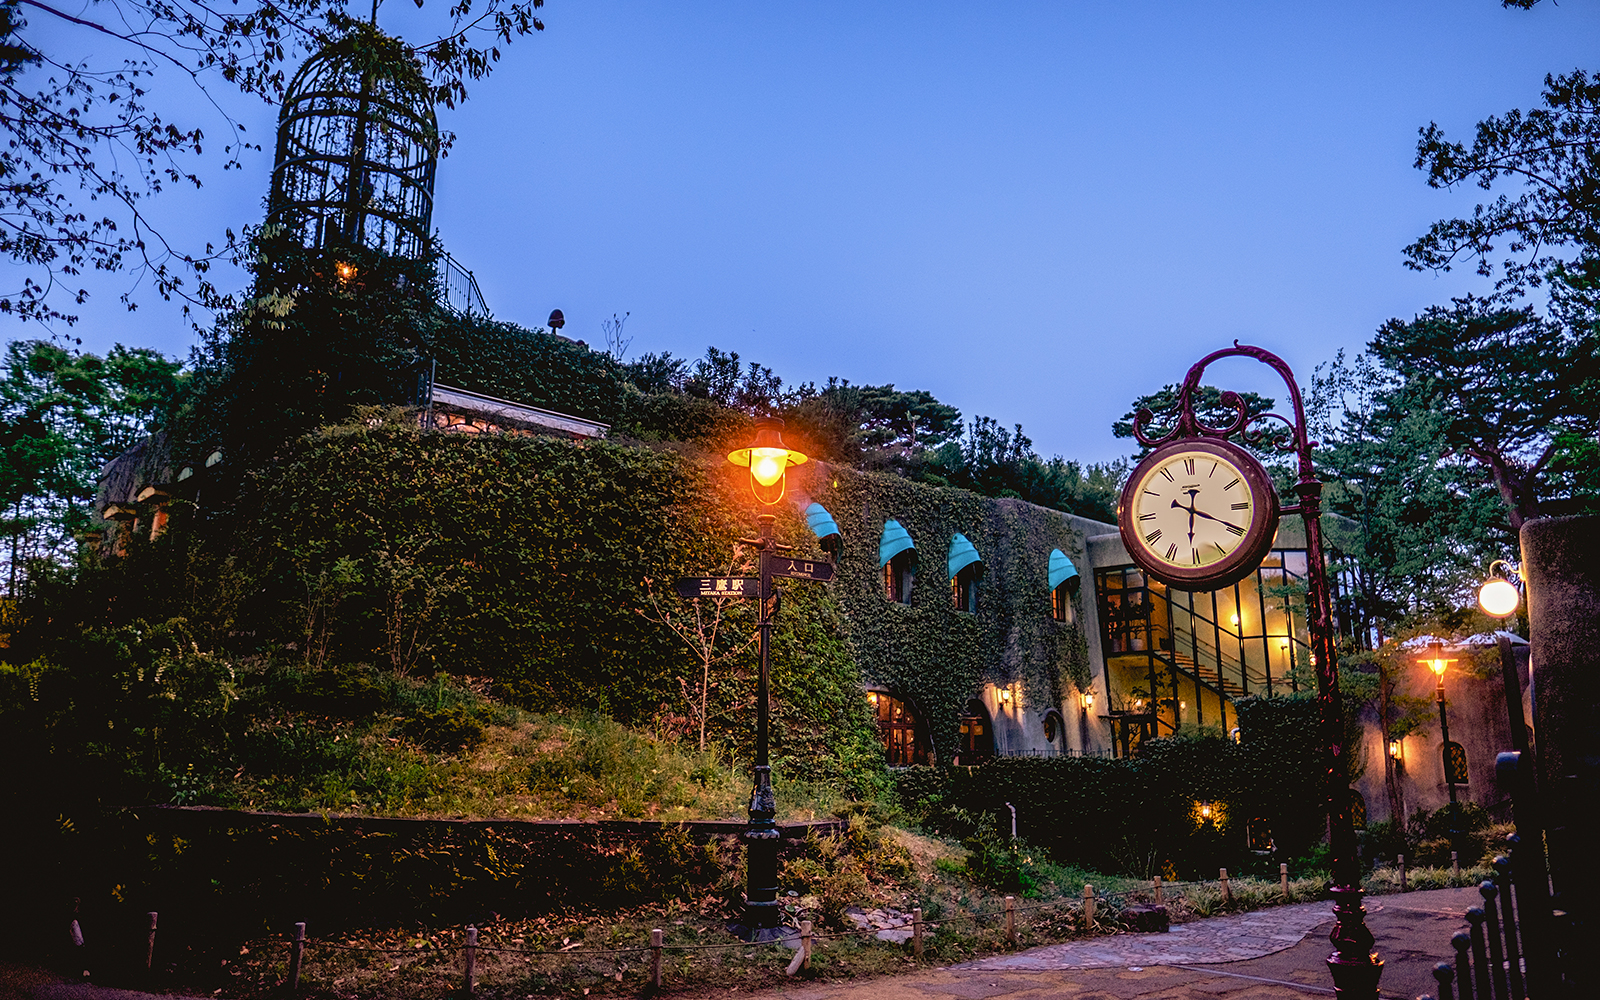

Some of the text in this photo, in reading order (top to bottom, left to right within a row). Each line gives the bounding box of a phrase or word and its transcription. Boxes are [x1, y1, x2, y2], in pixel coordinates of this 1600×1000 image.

[787, 560, 814, 573] 入口
[699, 579, 744, 591] 三鷹駅
